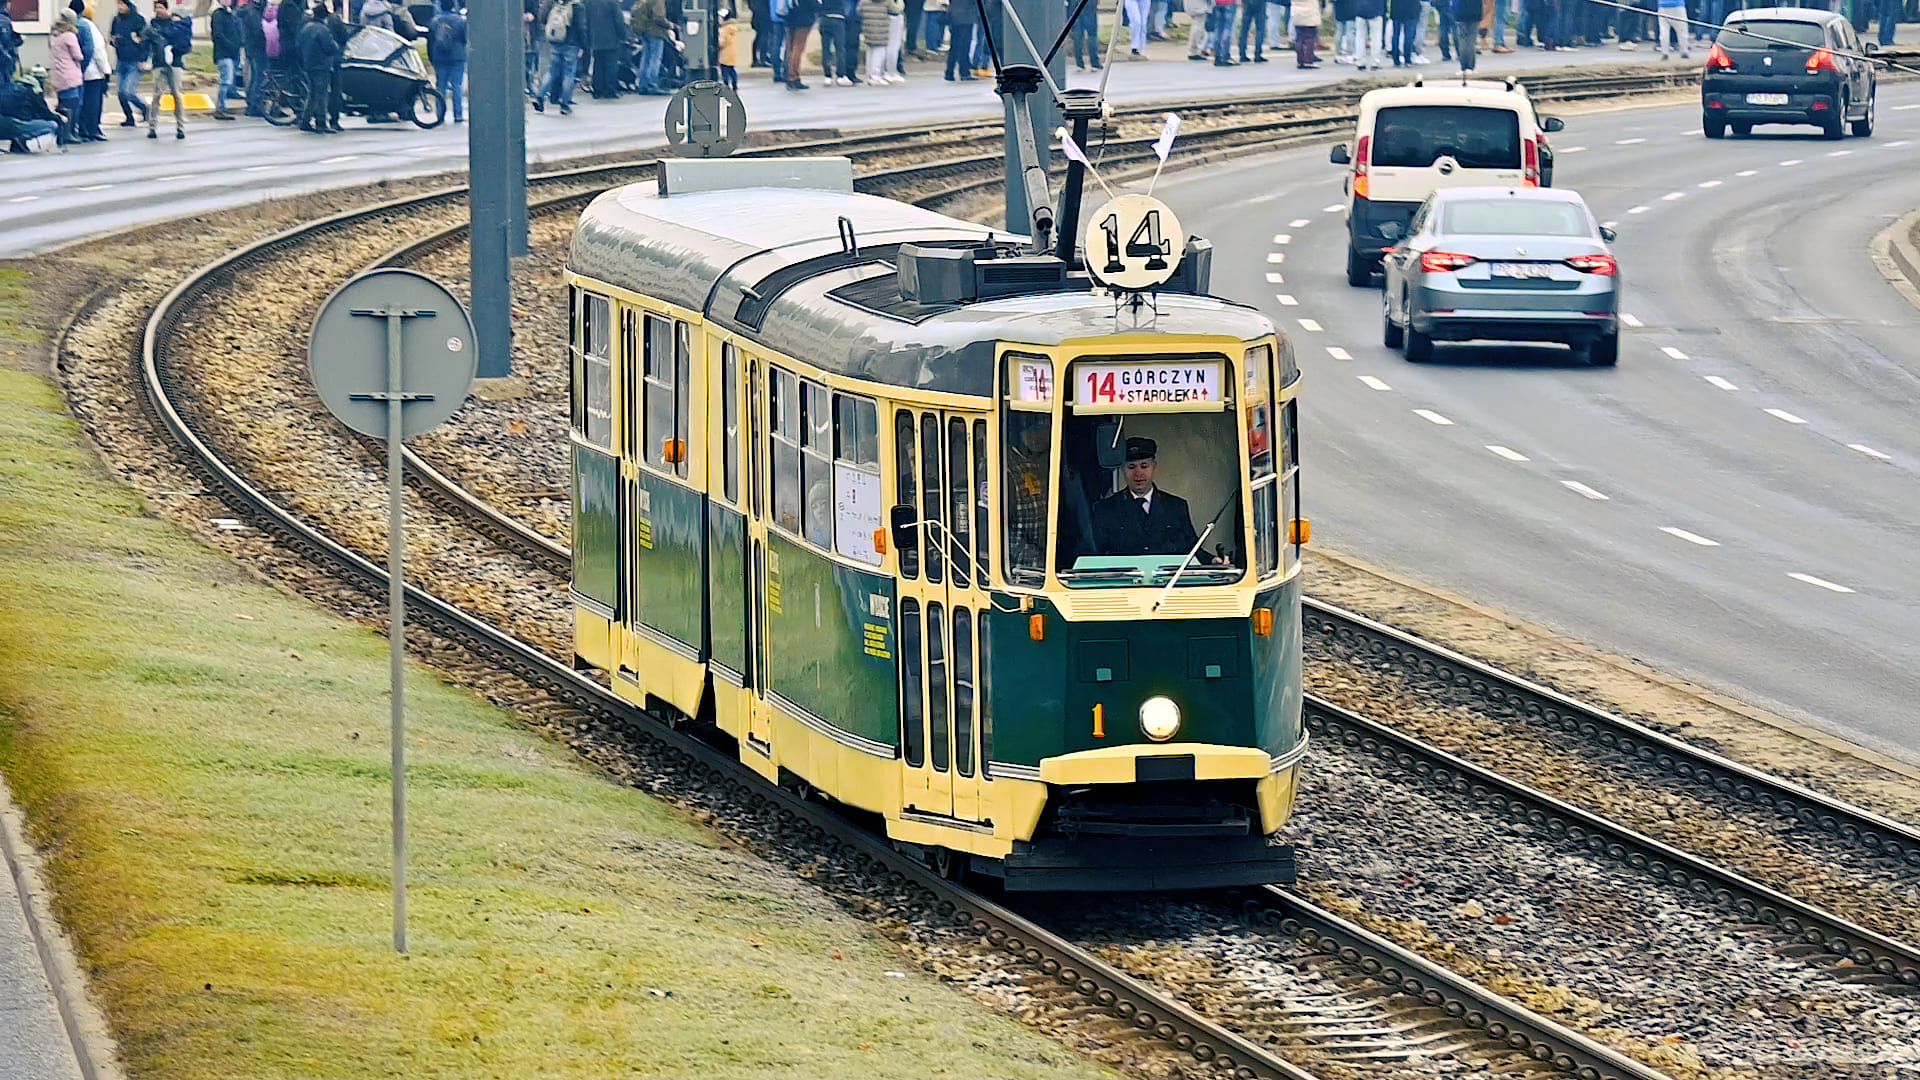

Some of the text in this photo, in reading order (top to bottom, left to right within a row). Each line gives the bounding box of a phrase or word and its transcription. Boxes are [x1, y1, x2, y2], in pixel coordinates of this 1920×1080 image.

[1100, 210, 1170, 273] 14
[1087, 372, 1116, 403] 14
[1122, 368, 1205, 385] GÓRCZYN
[1091, 703, 1105, 738] 1
